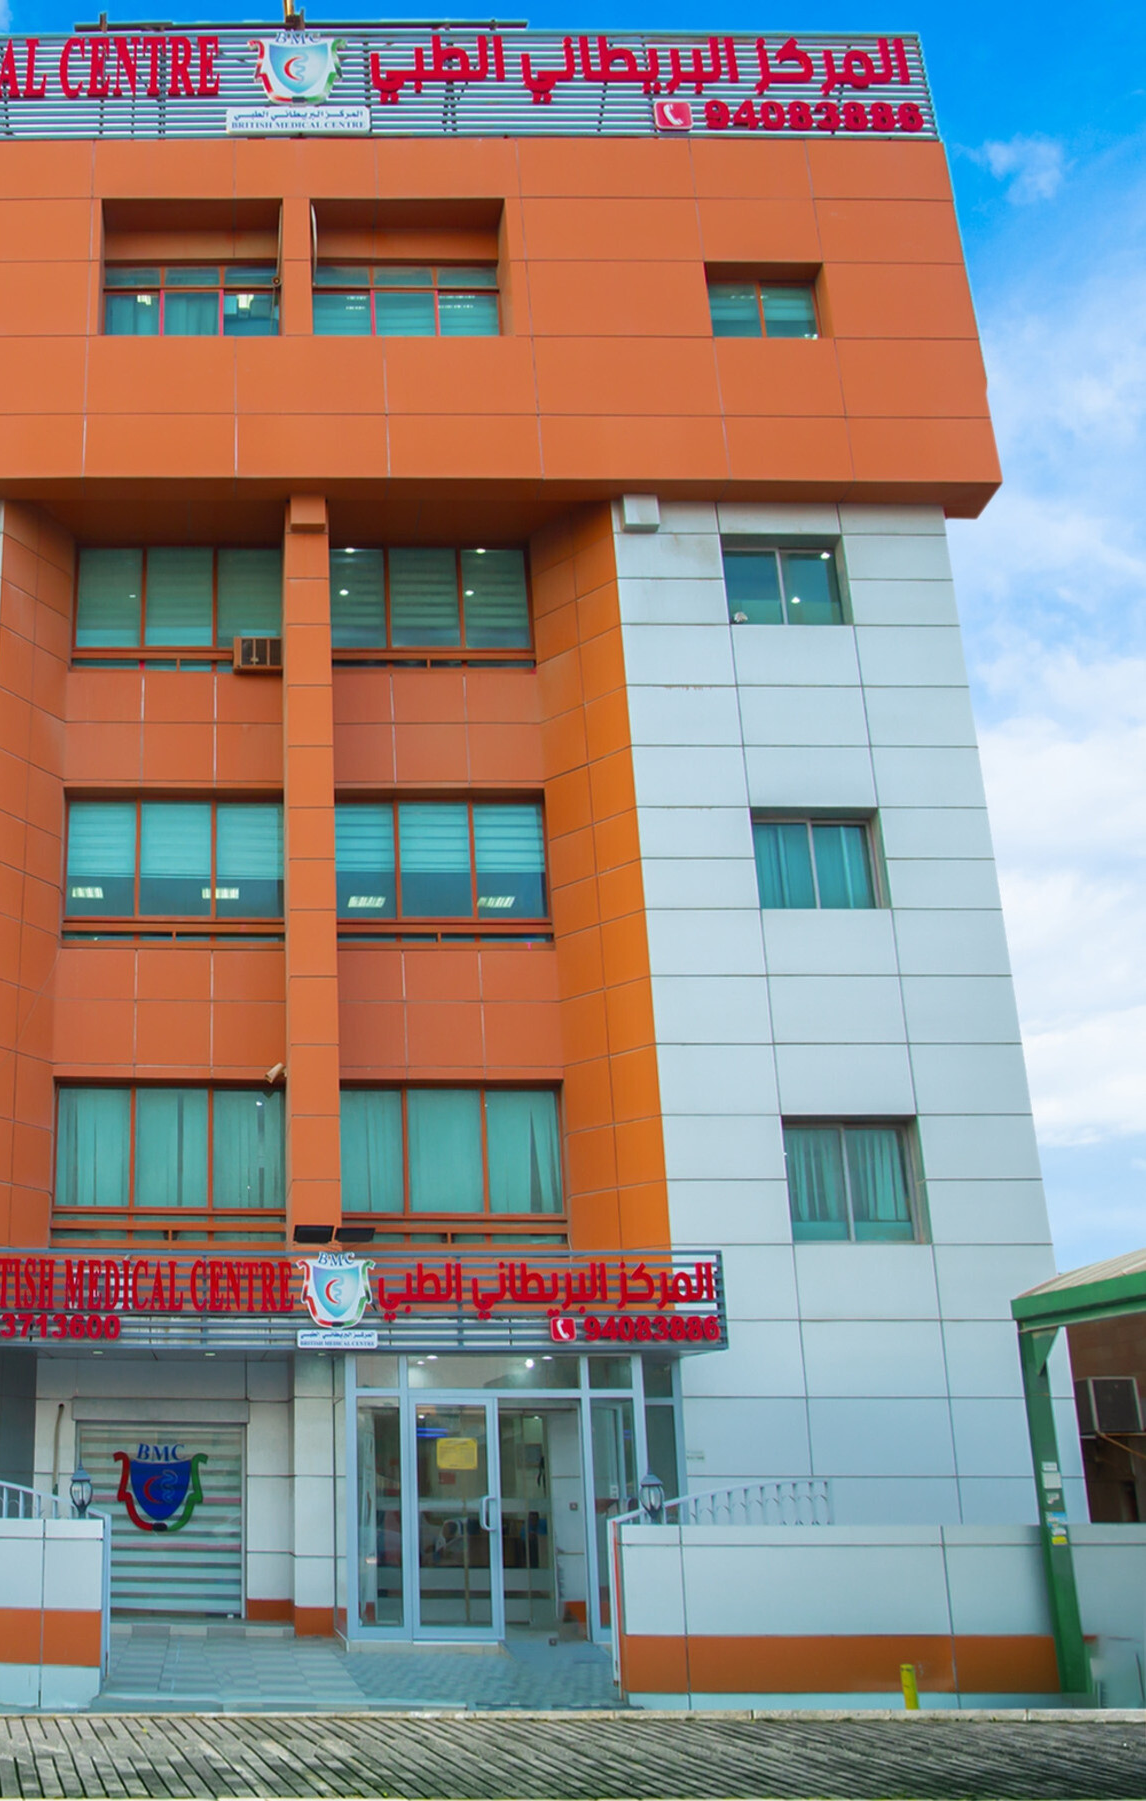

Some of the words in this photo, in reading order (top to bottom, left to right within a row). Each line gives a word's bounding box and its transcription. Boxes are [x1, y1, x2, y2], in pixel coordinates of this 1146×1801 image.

[275, 31, 322, 45] BMC
[59, 34, 220, 99] CENTRE
[370, 35, 505, 105] الطبي
[521, 36, 739, 104] البريطاني
[754, 36, 911, 95] المركز
[231, 121, 273, 129] BRITISH
[704, 99, 925, 132] 94083886
[318, 1252, 355, 1267] BMC
[617, 1261, 716, 1309] المركز
[62, 1258, 185, 1311] MEDICAL
[189, 1260, 296, 1313] CENTRE
[378, 1262, 463, 1322] الطبي
[471, 1261, 608, 1321] البريطاني
[583, 1315, 721, 1342] 94083886
[136, 1443, 186, 1462] BMC
